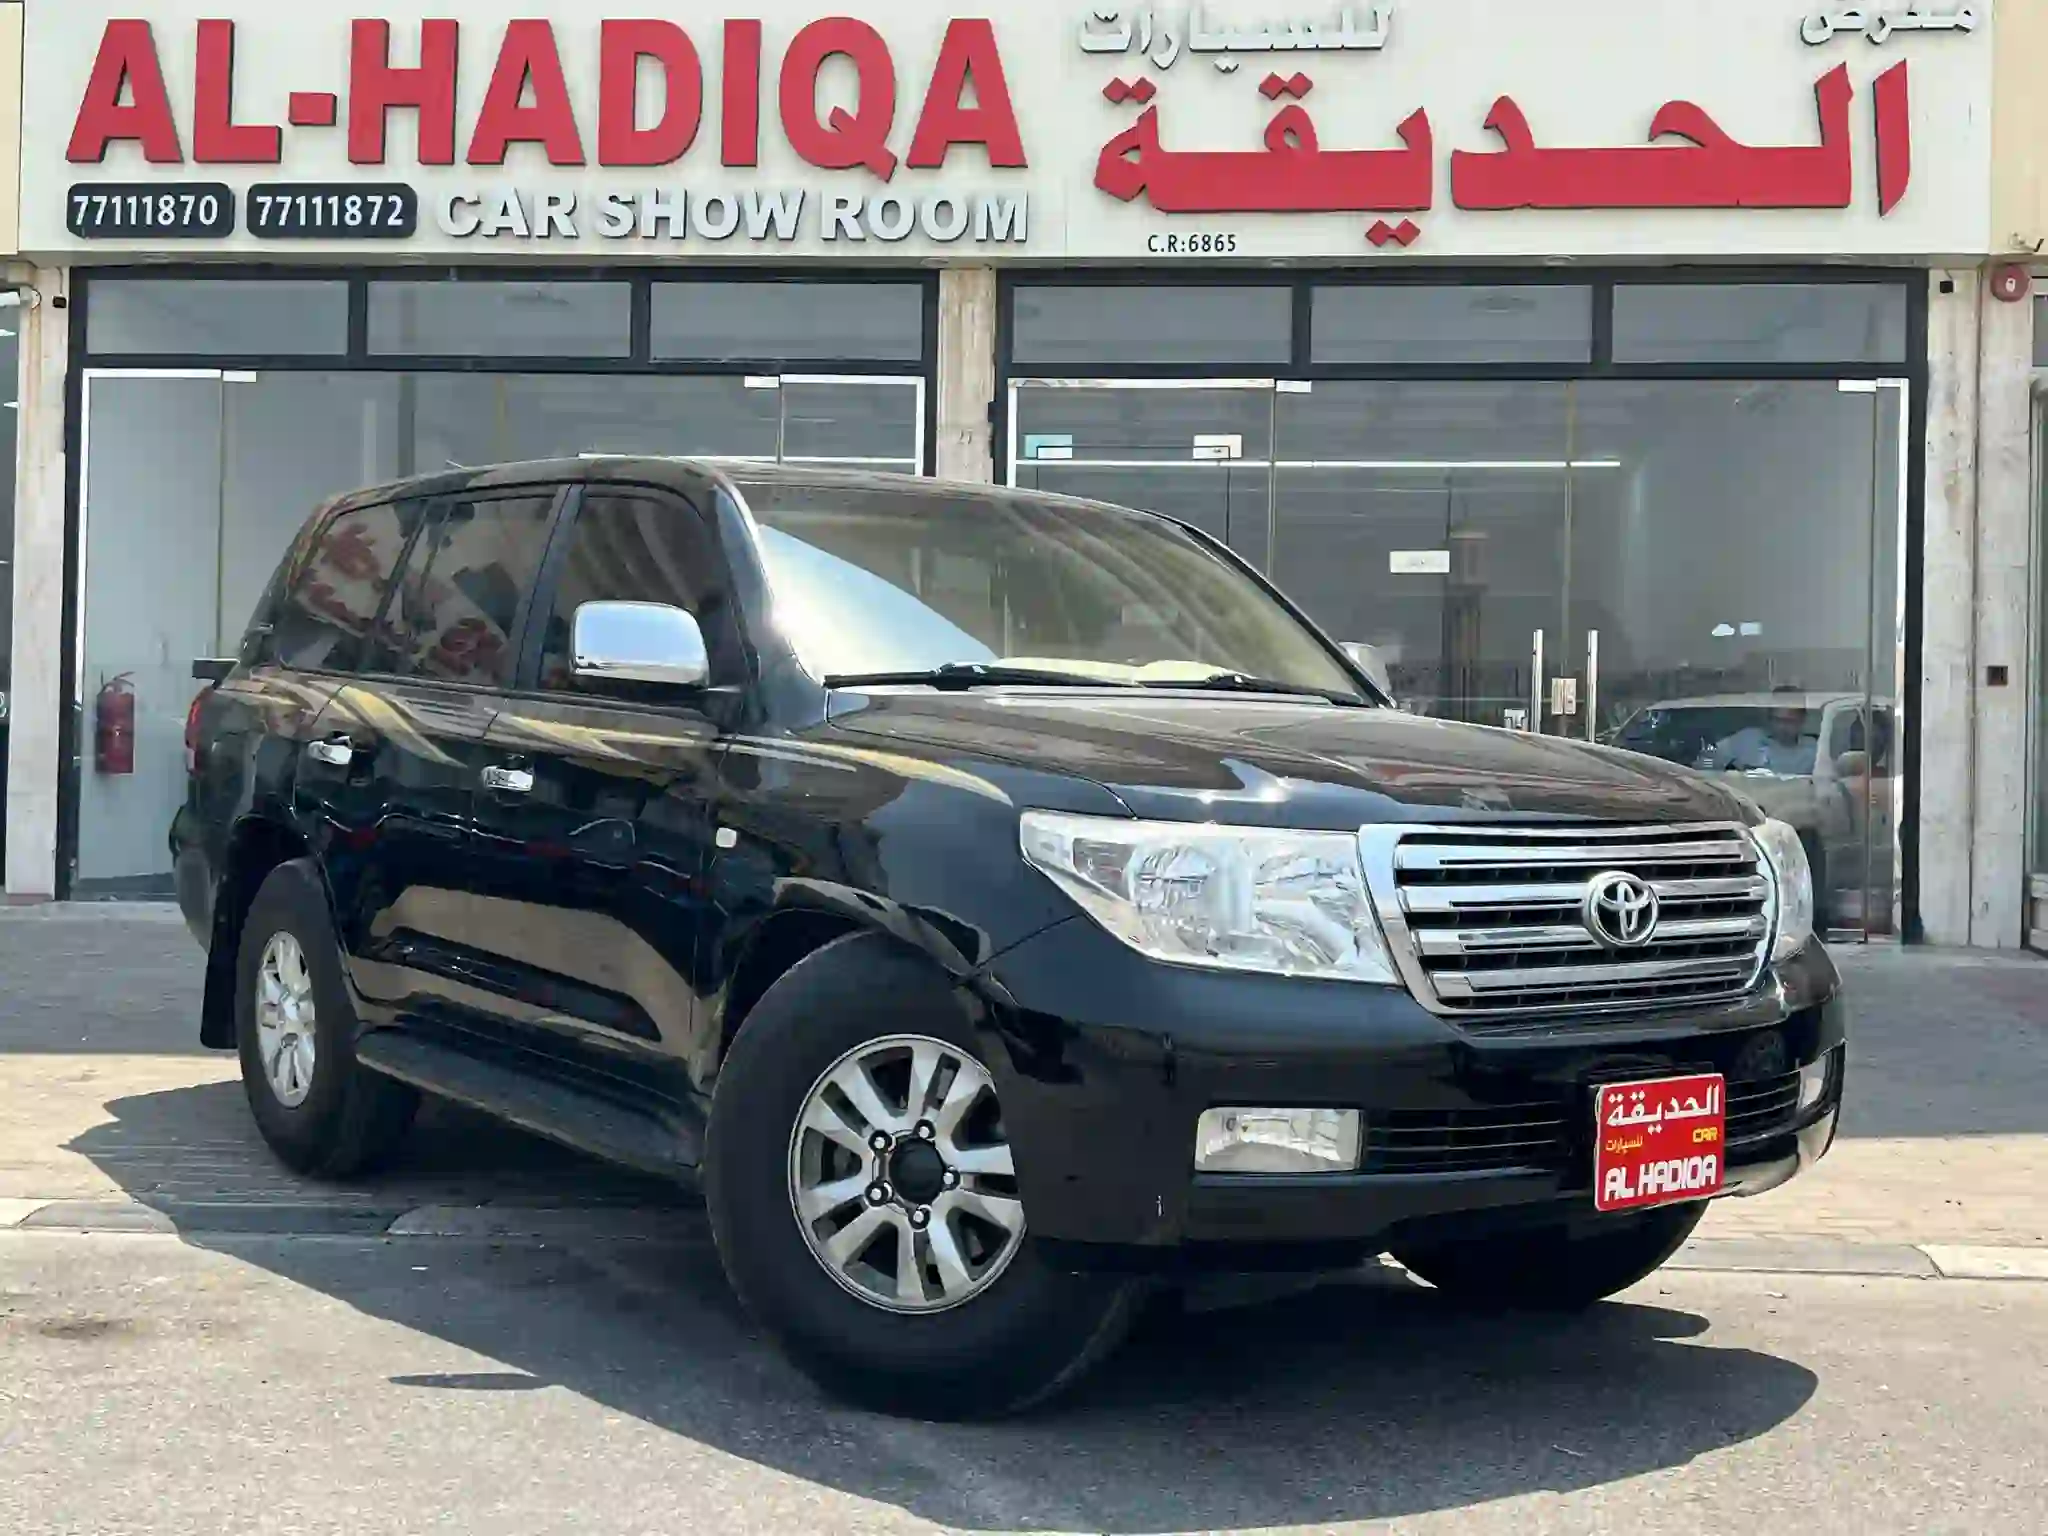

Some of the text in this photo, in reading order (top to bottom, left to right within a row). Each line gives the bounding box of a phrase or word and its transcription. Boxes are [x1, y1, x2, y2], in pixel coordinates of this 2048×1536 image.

[1080, 1, 1394, 73] للسيارات
[65, 17, 1029, 183] AL-HADIQA
[1094, 58, 1911, 248] الحديقة
[73, 195, 219, 226] 77111870
[256, 195, 404, 226] 77111872
[436, 188, 1029, 243] CAR SHOW ROOM
[1147, 233, 1237, 253] C.R:6865
[1606, 1083, 1720, 1135] الحديقة
[1605, 1134, 1643, 1154] للسيارات
[1692, 1126, 1718, 1143] CAR
[1603, 1166, 1635, 1202] AL
